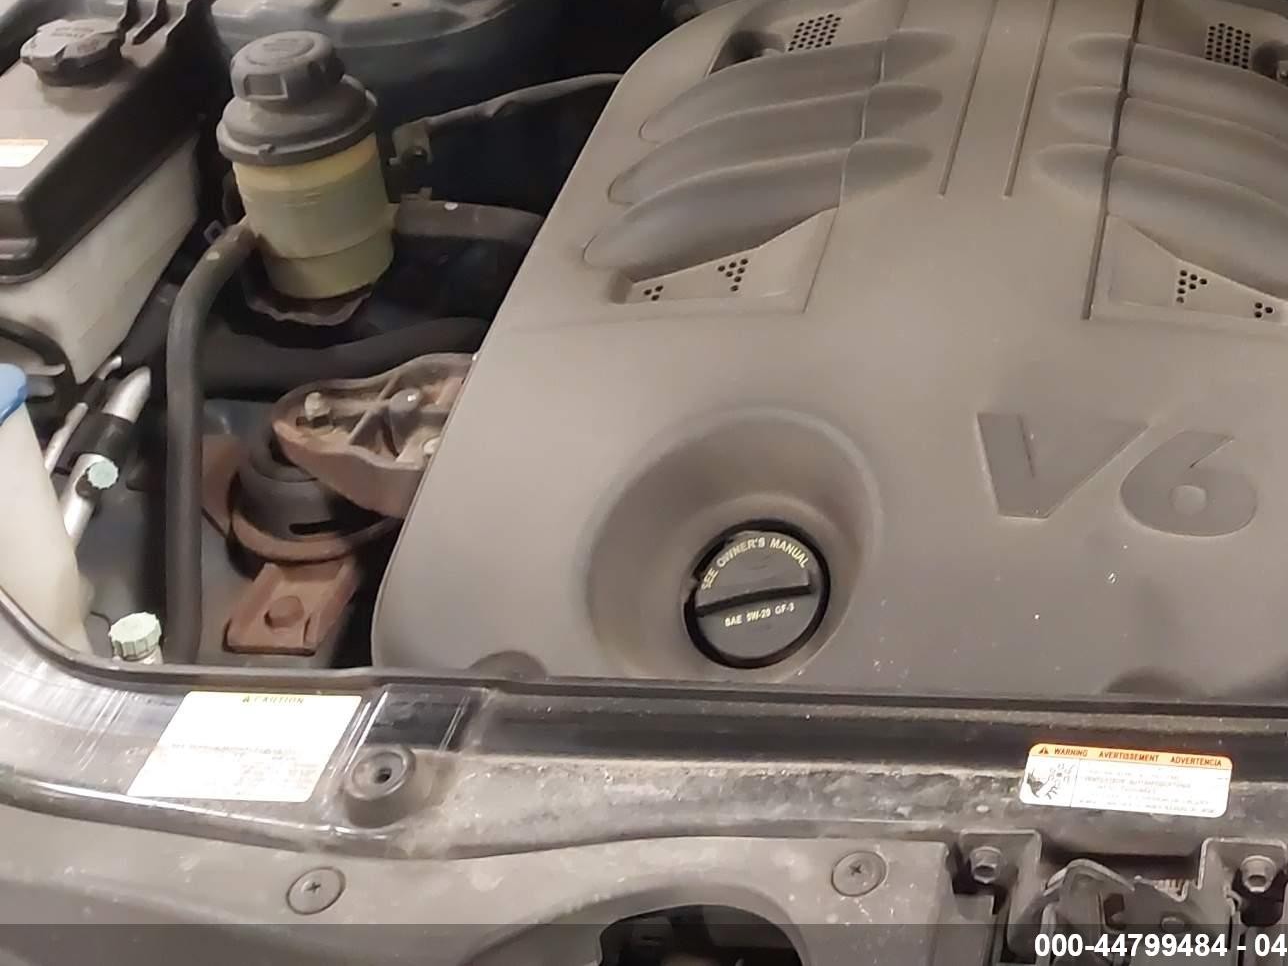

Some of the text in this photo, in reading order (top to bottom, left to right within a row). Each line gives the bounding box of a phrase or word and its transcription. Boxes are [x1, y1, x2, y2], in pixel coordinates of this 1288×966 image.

[976, 411, 1259, 538] V6
[701, 537, 809, 590] SEE OWNER'S MANUAL
[724, 614, 743, 627] SAE
[1053, 746, 1222, 767] WARNING AVERTISSEMENT ADVERTENCIA
